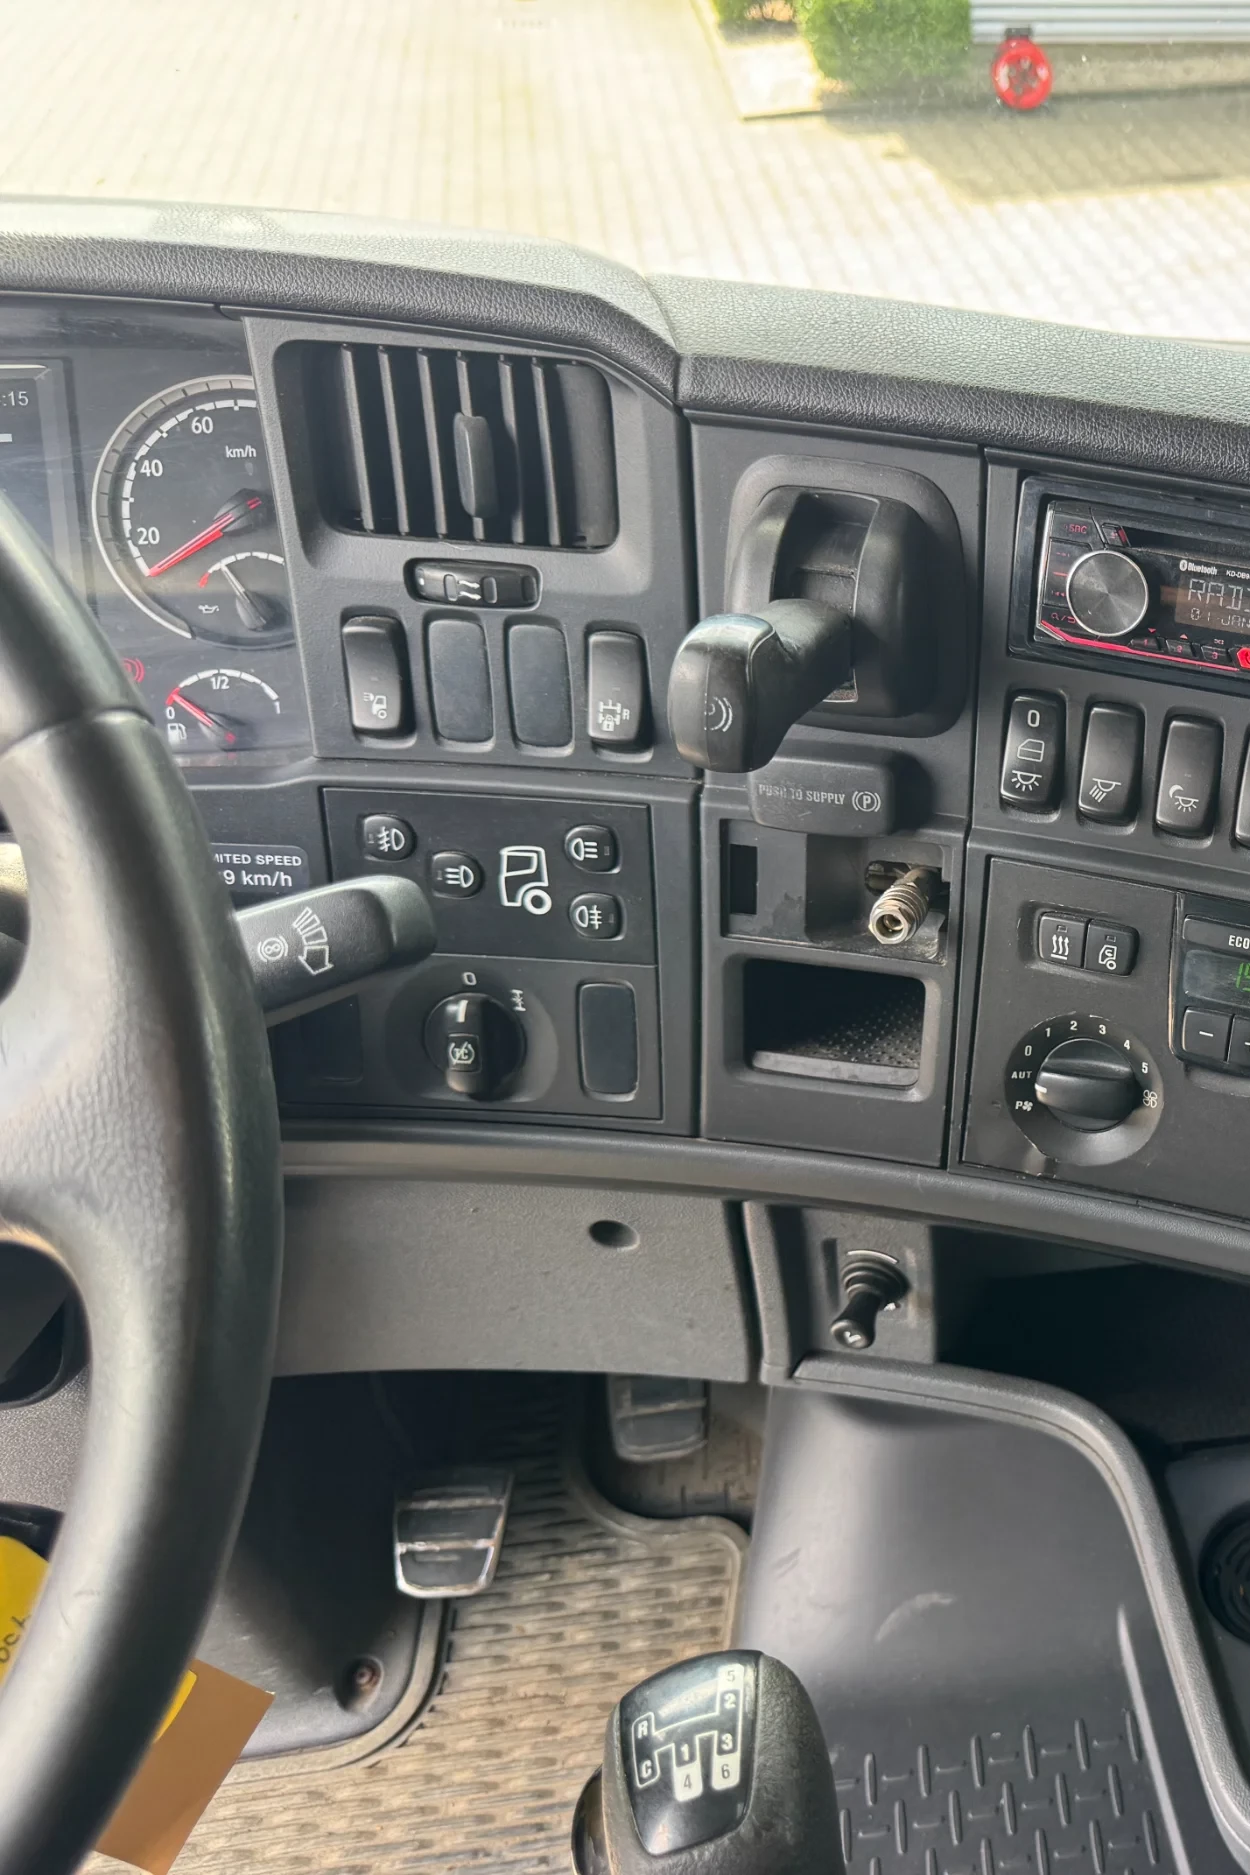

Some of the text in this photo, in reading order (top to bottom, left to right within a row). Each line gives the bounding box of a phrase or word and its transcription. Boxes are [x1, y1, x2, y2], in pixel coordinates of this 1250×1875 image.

[191, 416, 214, 434] 60
[225, 445, 257, 459] km/h
[140, 459, 163, 477] 40
[137, 527, 160, 545] 20
[210, 675, 230, 691] 1/2
[166, 706, 175, 720] 0
[274, 701, 281, 714] 1
[790, 788, 803, 801] TO
[806, 790, 845, 805] SUPPLY
[255, 855, 302, 866] SPEED
[241, 870, 293, 887] km/h
[1045, 1027, 1052, 1039] 1
[1070, 1020, 1078, 1031] 2
[1098, 1024, 1107, 1036] 3
[1024, 1045, 1032, 1056] 0
[1123, 1039, 1131, 1051] 4
[1011, 1070, 1032, 1080] AUT
[1141, 1062, 1149, 1074] 5
[726, 1669, 736, 1682] 5
[724, 1692, 736, 1709] 2
[637, 1720, 648, 1739] R
[720, 1733, 733, 1750] 3
[681, 1743, 689, 1762] 1
[641, 1759, 652, 1778] C
[721, 1763, 731, 1779] 6
[683, 1774, 692, 1790] 4
